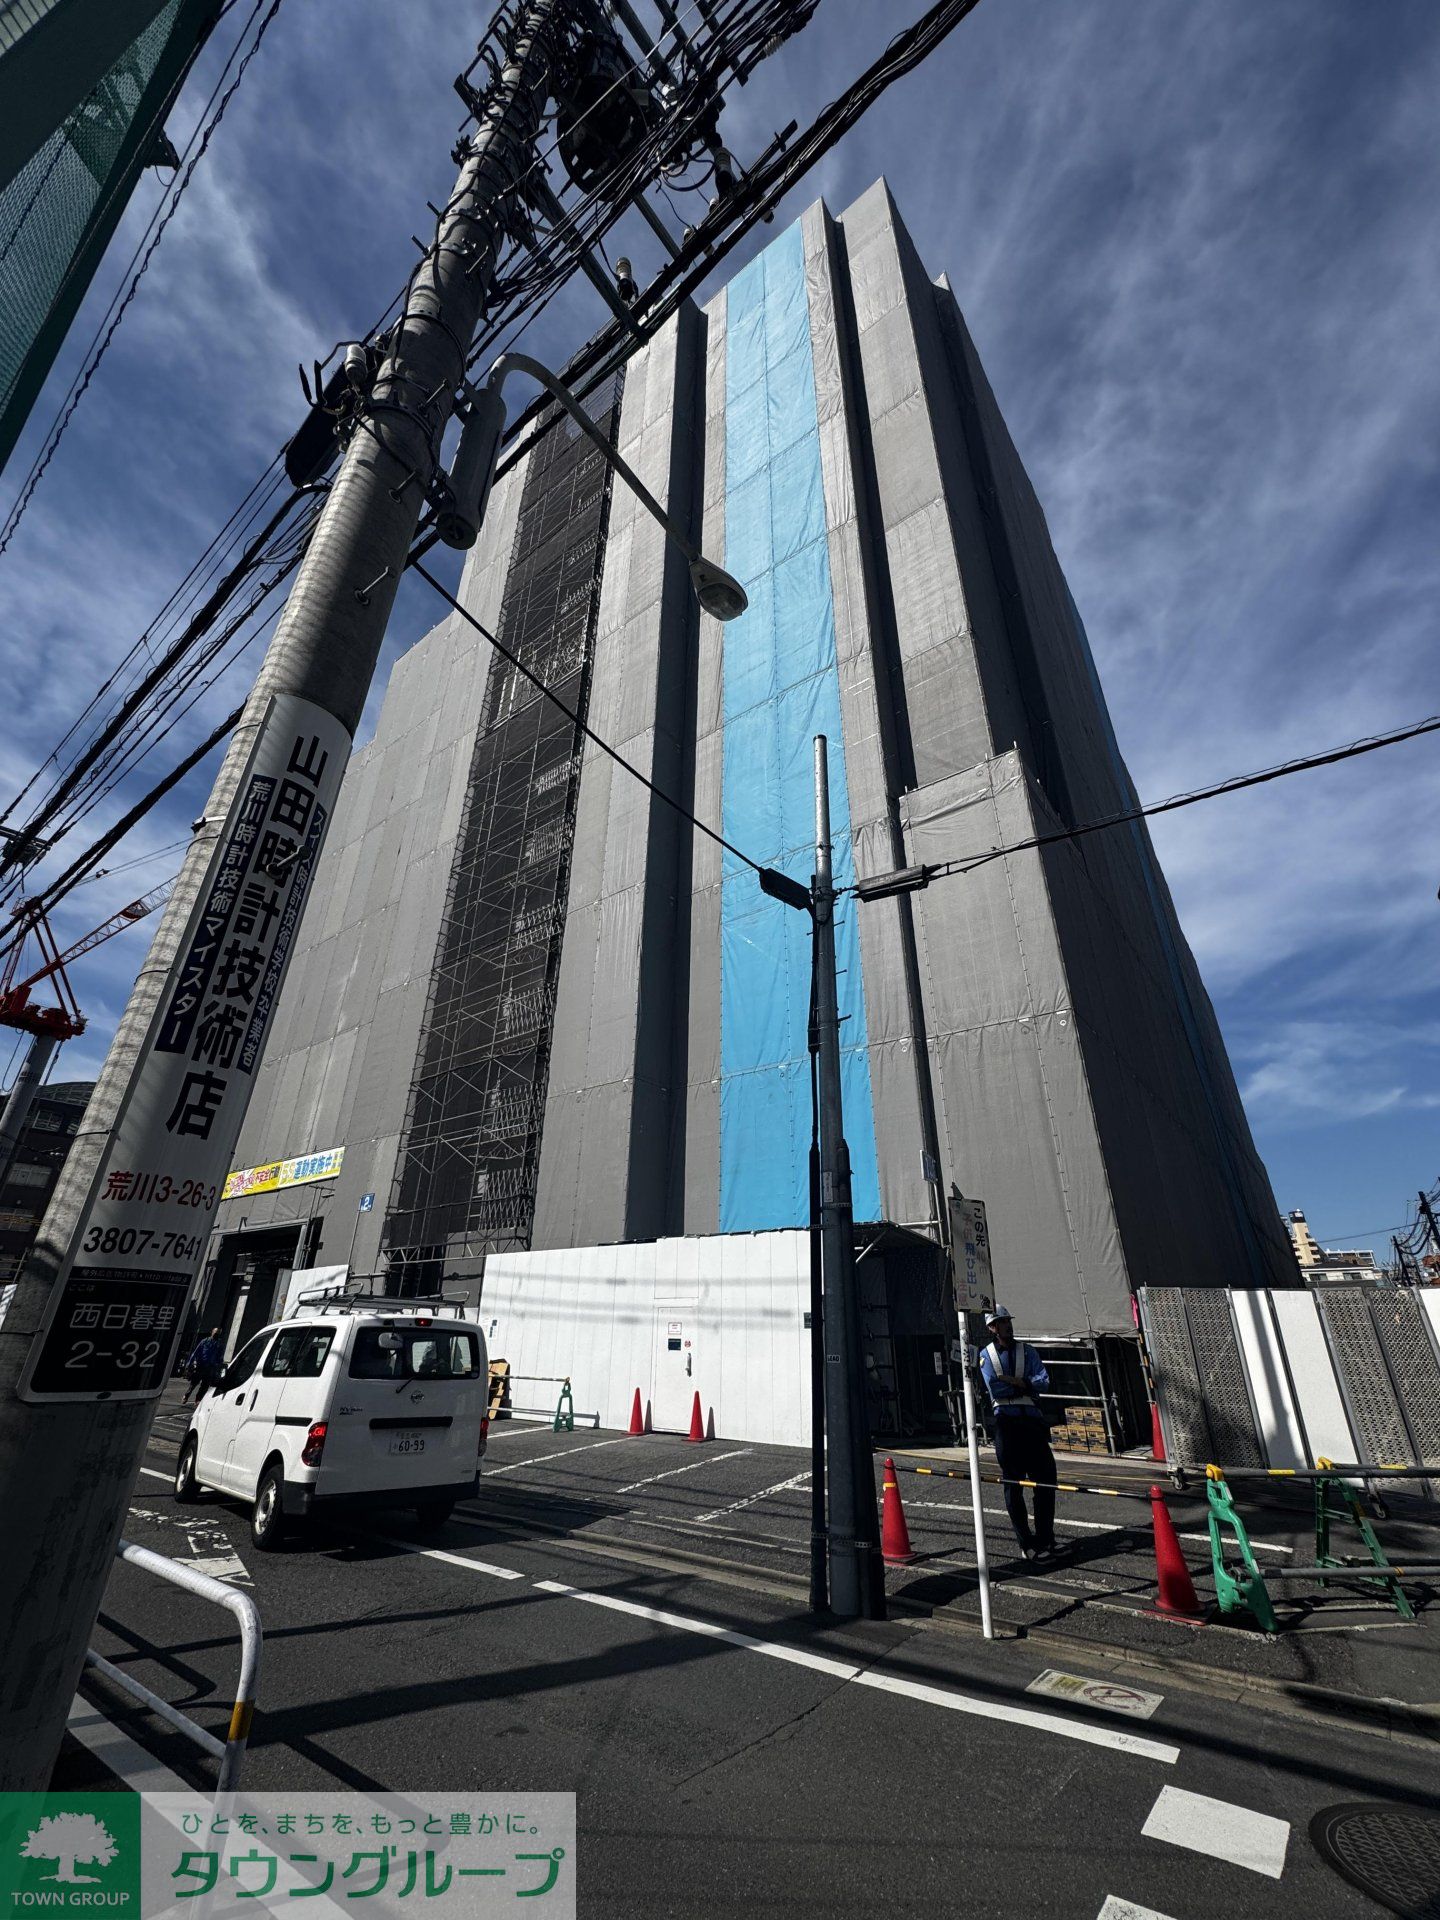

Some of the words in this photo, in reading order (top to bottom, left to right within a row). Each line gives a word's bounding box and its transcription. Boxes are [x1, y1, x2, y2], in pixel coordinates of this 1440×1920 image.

[170, 781, 271, 1044] 荒川時計技術マイスター
[166, 736, 328, 1140] 山田時計技術店
[102, 1170, 216, 1211] 荒川3-26-3
[83, 1226, 201, 1261] 3807-7641
[69, 1303, 176, 1331] 西日暮里
[65, 1341, 160, 1369] 2-32
